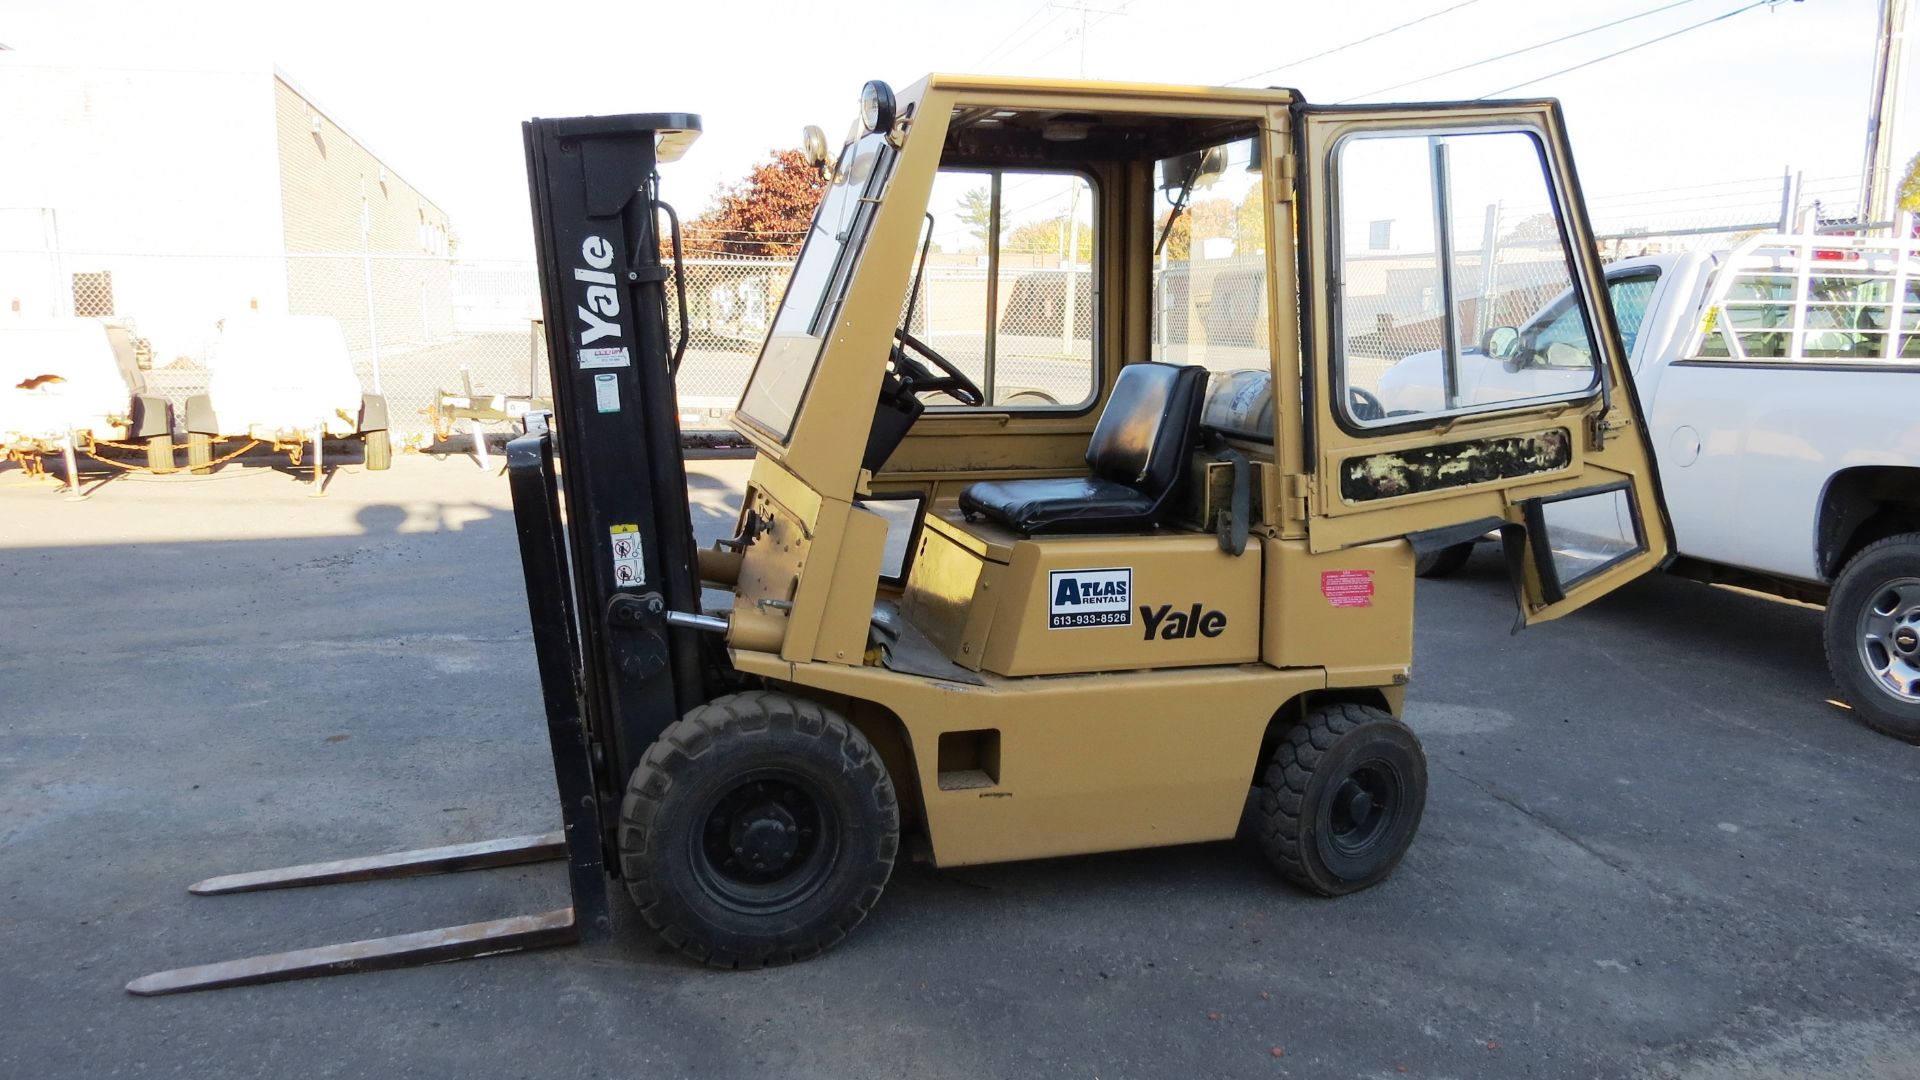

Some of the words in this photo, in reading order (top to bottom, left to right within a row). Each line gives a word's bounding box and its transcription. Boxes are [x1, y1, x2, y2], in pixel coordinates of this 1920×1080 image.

[574, 235, 621, 345] Yale
[1055, 578, 1127, 605] ATLAS
[1082, 595, 1127, 605] RENTALS
[1053, 613, 1127, 626] 613-933-8526
[1139, 603, 1227, 640] Yale
